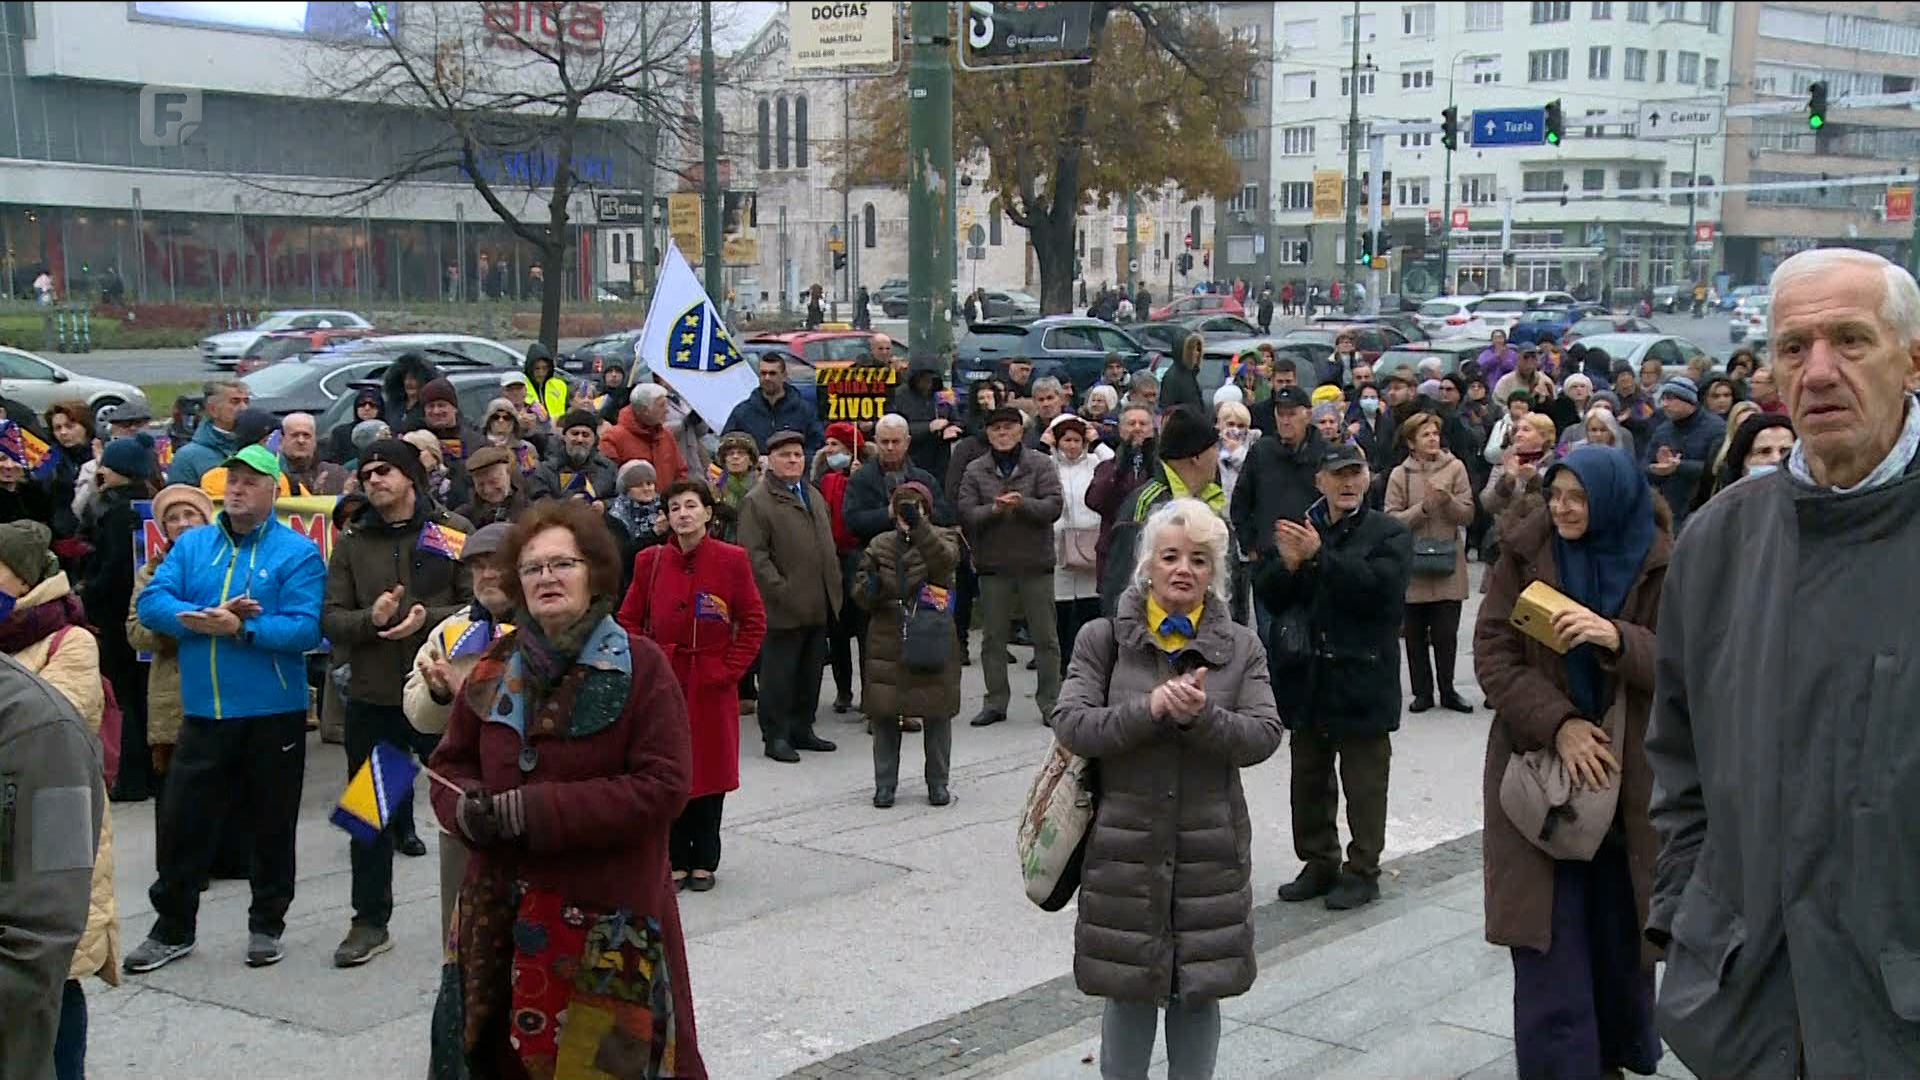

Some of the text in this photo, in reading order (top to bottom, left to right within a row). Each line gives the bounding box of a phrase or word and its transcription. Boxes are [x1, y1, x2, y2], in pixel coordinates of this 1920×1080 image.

[1671, 111, 1711, 123] Centar
[1505, 120, 1533, 132] Tuzla
[828, 394, 887, 419] ŽIVOT
